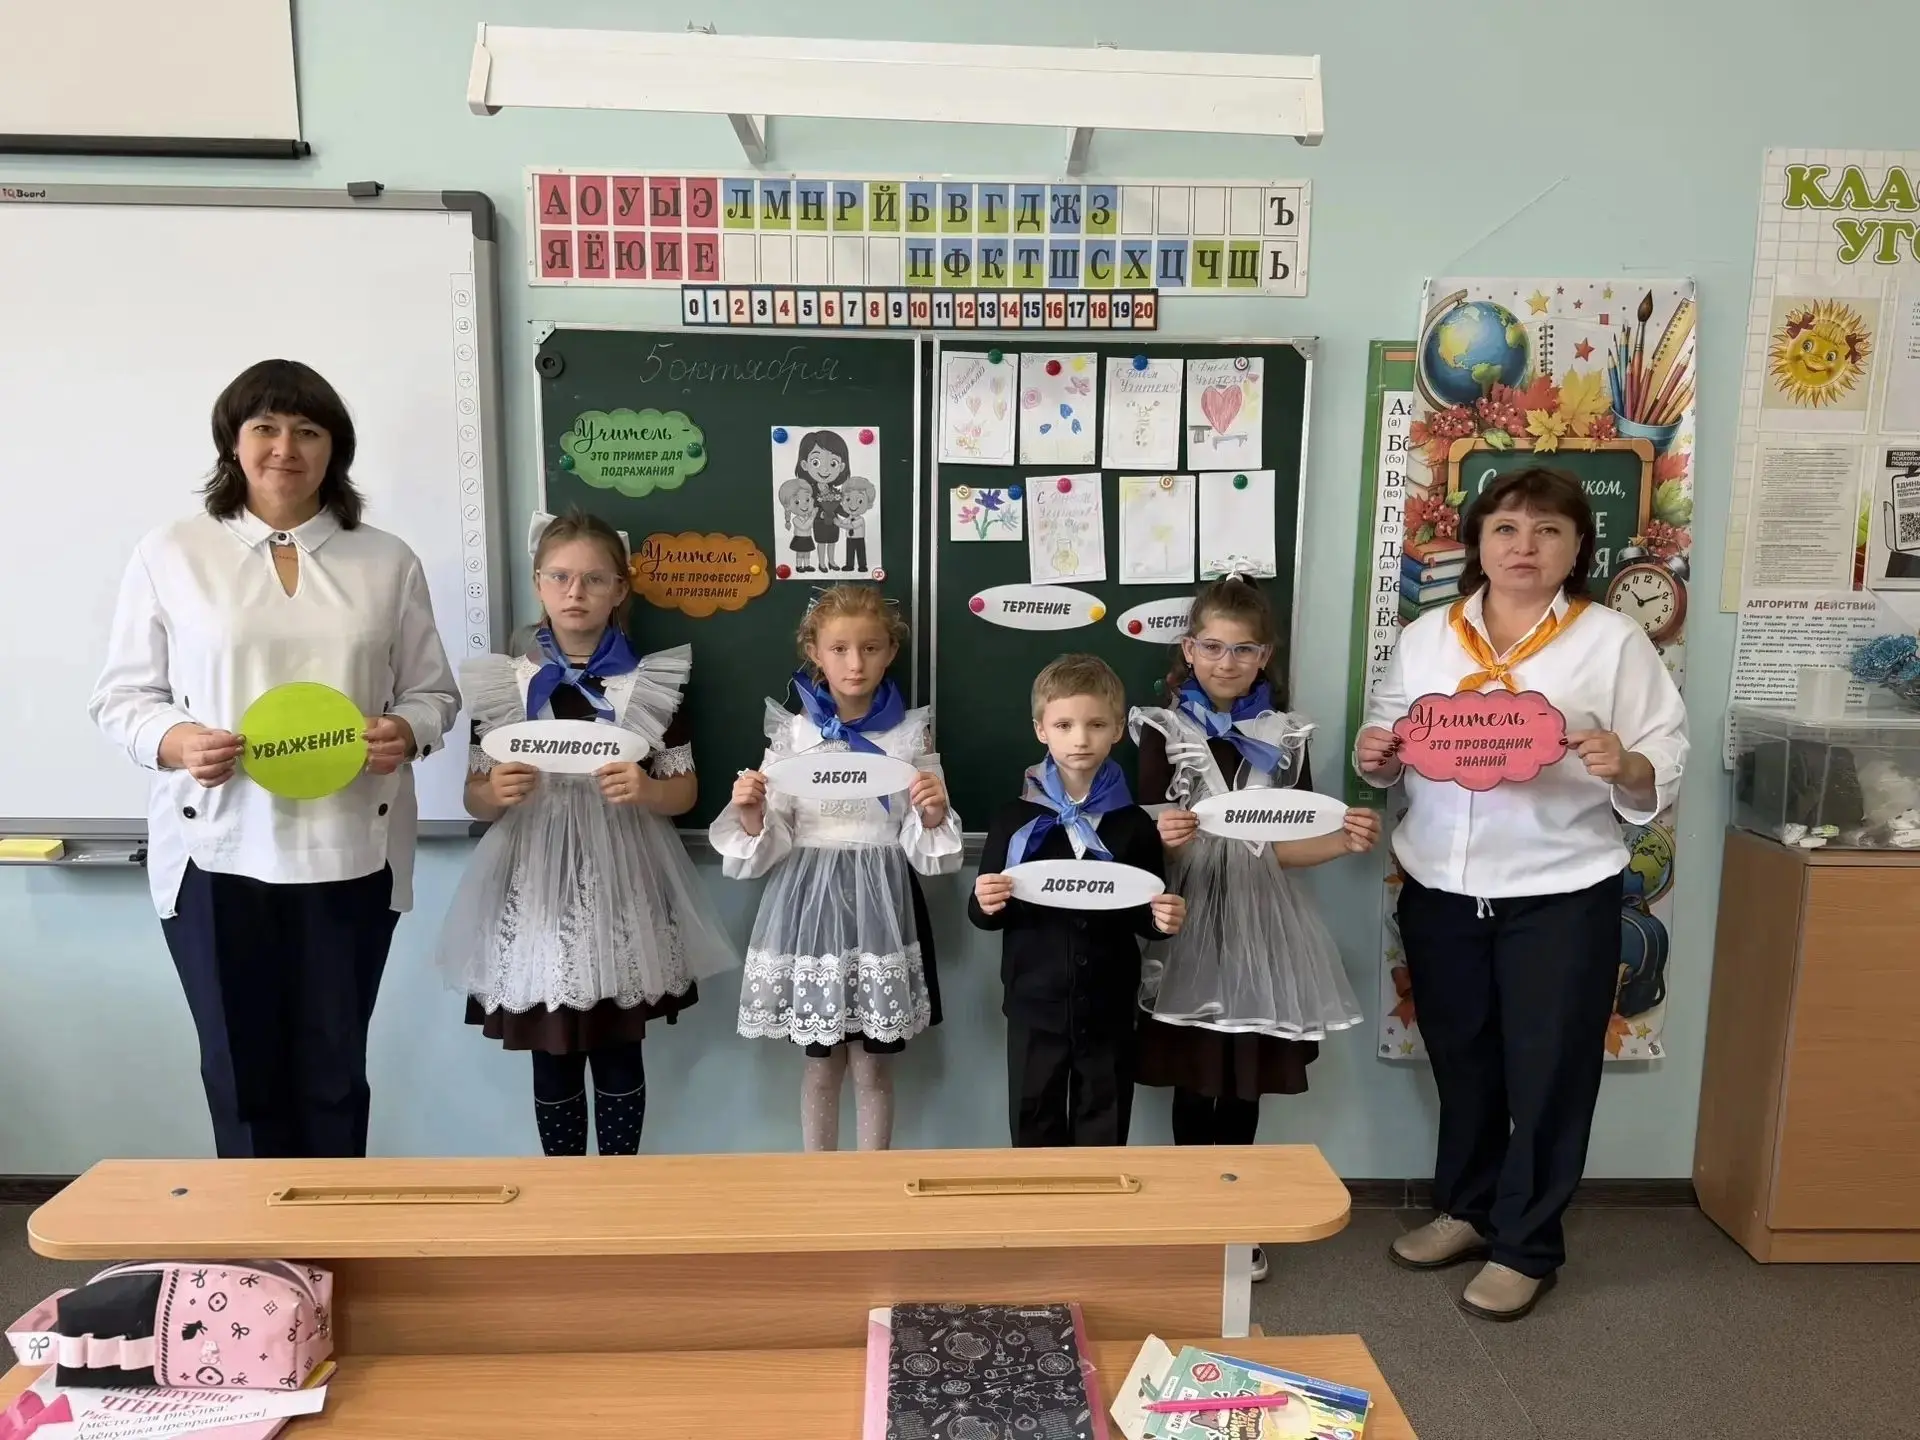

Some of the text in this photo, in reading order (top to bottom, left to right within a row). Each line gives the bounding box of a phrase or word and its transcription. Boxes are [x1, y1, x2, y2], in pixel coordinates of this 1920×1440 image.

[1782, 164, 1920, 212] КЛА
[544, 185, 1294, 231] А О У Ы Э Л М Н Р Й Б В Г Д Ж З Ъ
[1832, 218, 1920, 264] УГ
[546, 233, 1290, 285] Я Ё Ю И Е П Ф К Т Ш С Х Ц Ч Щ Ь
[689, 299, 1153, 320] 0 1 2 3 4 5 6 7 8 9 10 11 12 13 14 15 16 17 18 19 20
[640, 342, 674, 384] 5
[573, 418, 672, 454] Учитель
[590, 451, 683, 461] ЭТО ПРИМЕР ДЛЯ
[601, 466, 675, 477] ПОДРАЖАНИЯ
[640, 540, 737, 574] Учитель
[649, 573, 753, 584] ЭТО НЕ ПРОФЕССИЯ,
[1643, 575, 1653, 583] 12
[666, 588, 738, 598] А ПРИЗВАНИЕ
[1622, 583, 1630, 591] 10
[1615, 594, 1622, 602] 9
[1662, 592, 1669, 600] 2
[1002, 600, 1072, 616] ТЕРПЕНИЕ
[1662, 604, 1669, 613] 3
[1746, 600, 1876, 611] АЛГОРИТМ ДЕЙСТВИЙ
[1148, 615, 1189, 628] ЧЕСТН
[1644, 622, 1650, 631] 5
[1654, 616, 1661, 624] 4
[1409, 704, 1524, 742] Учитель
[252, 728, 356, 760] УВАЖЕНИЕ
[509, 738, 621, 756] ВЕЖЛИВОСТЬ
[1429, 738, 1533, 750] ЭТО ПРОВОДНИК
[1455, 753, 1507, 767] ЗНАНИЙ
[811, 771, 868, 785] ЗАБОТА
[1224, 809, 1316, 825] ВНИМАНИЕ
[1041, 877, 1115, 894] ДОБРОТА
